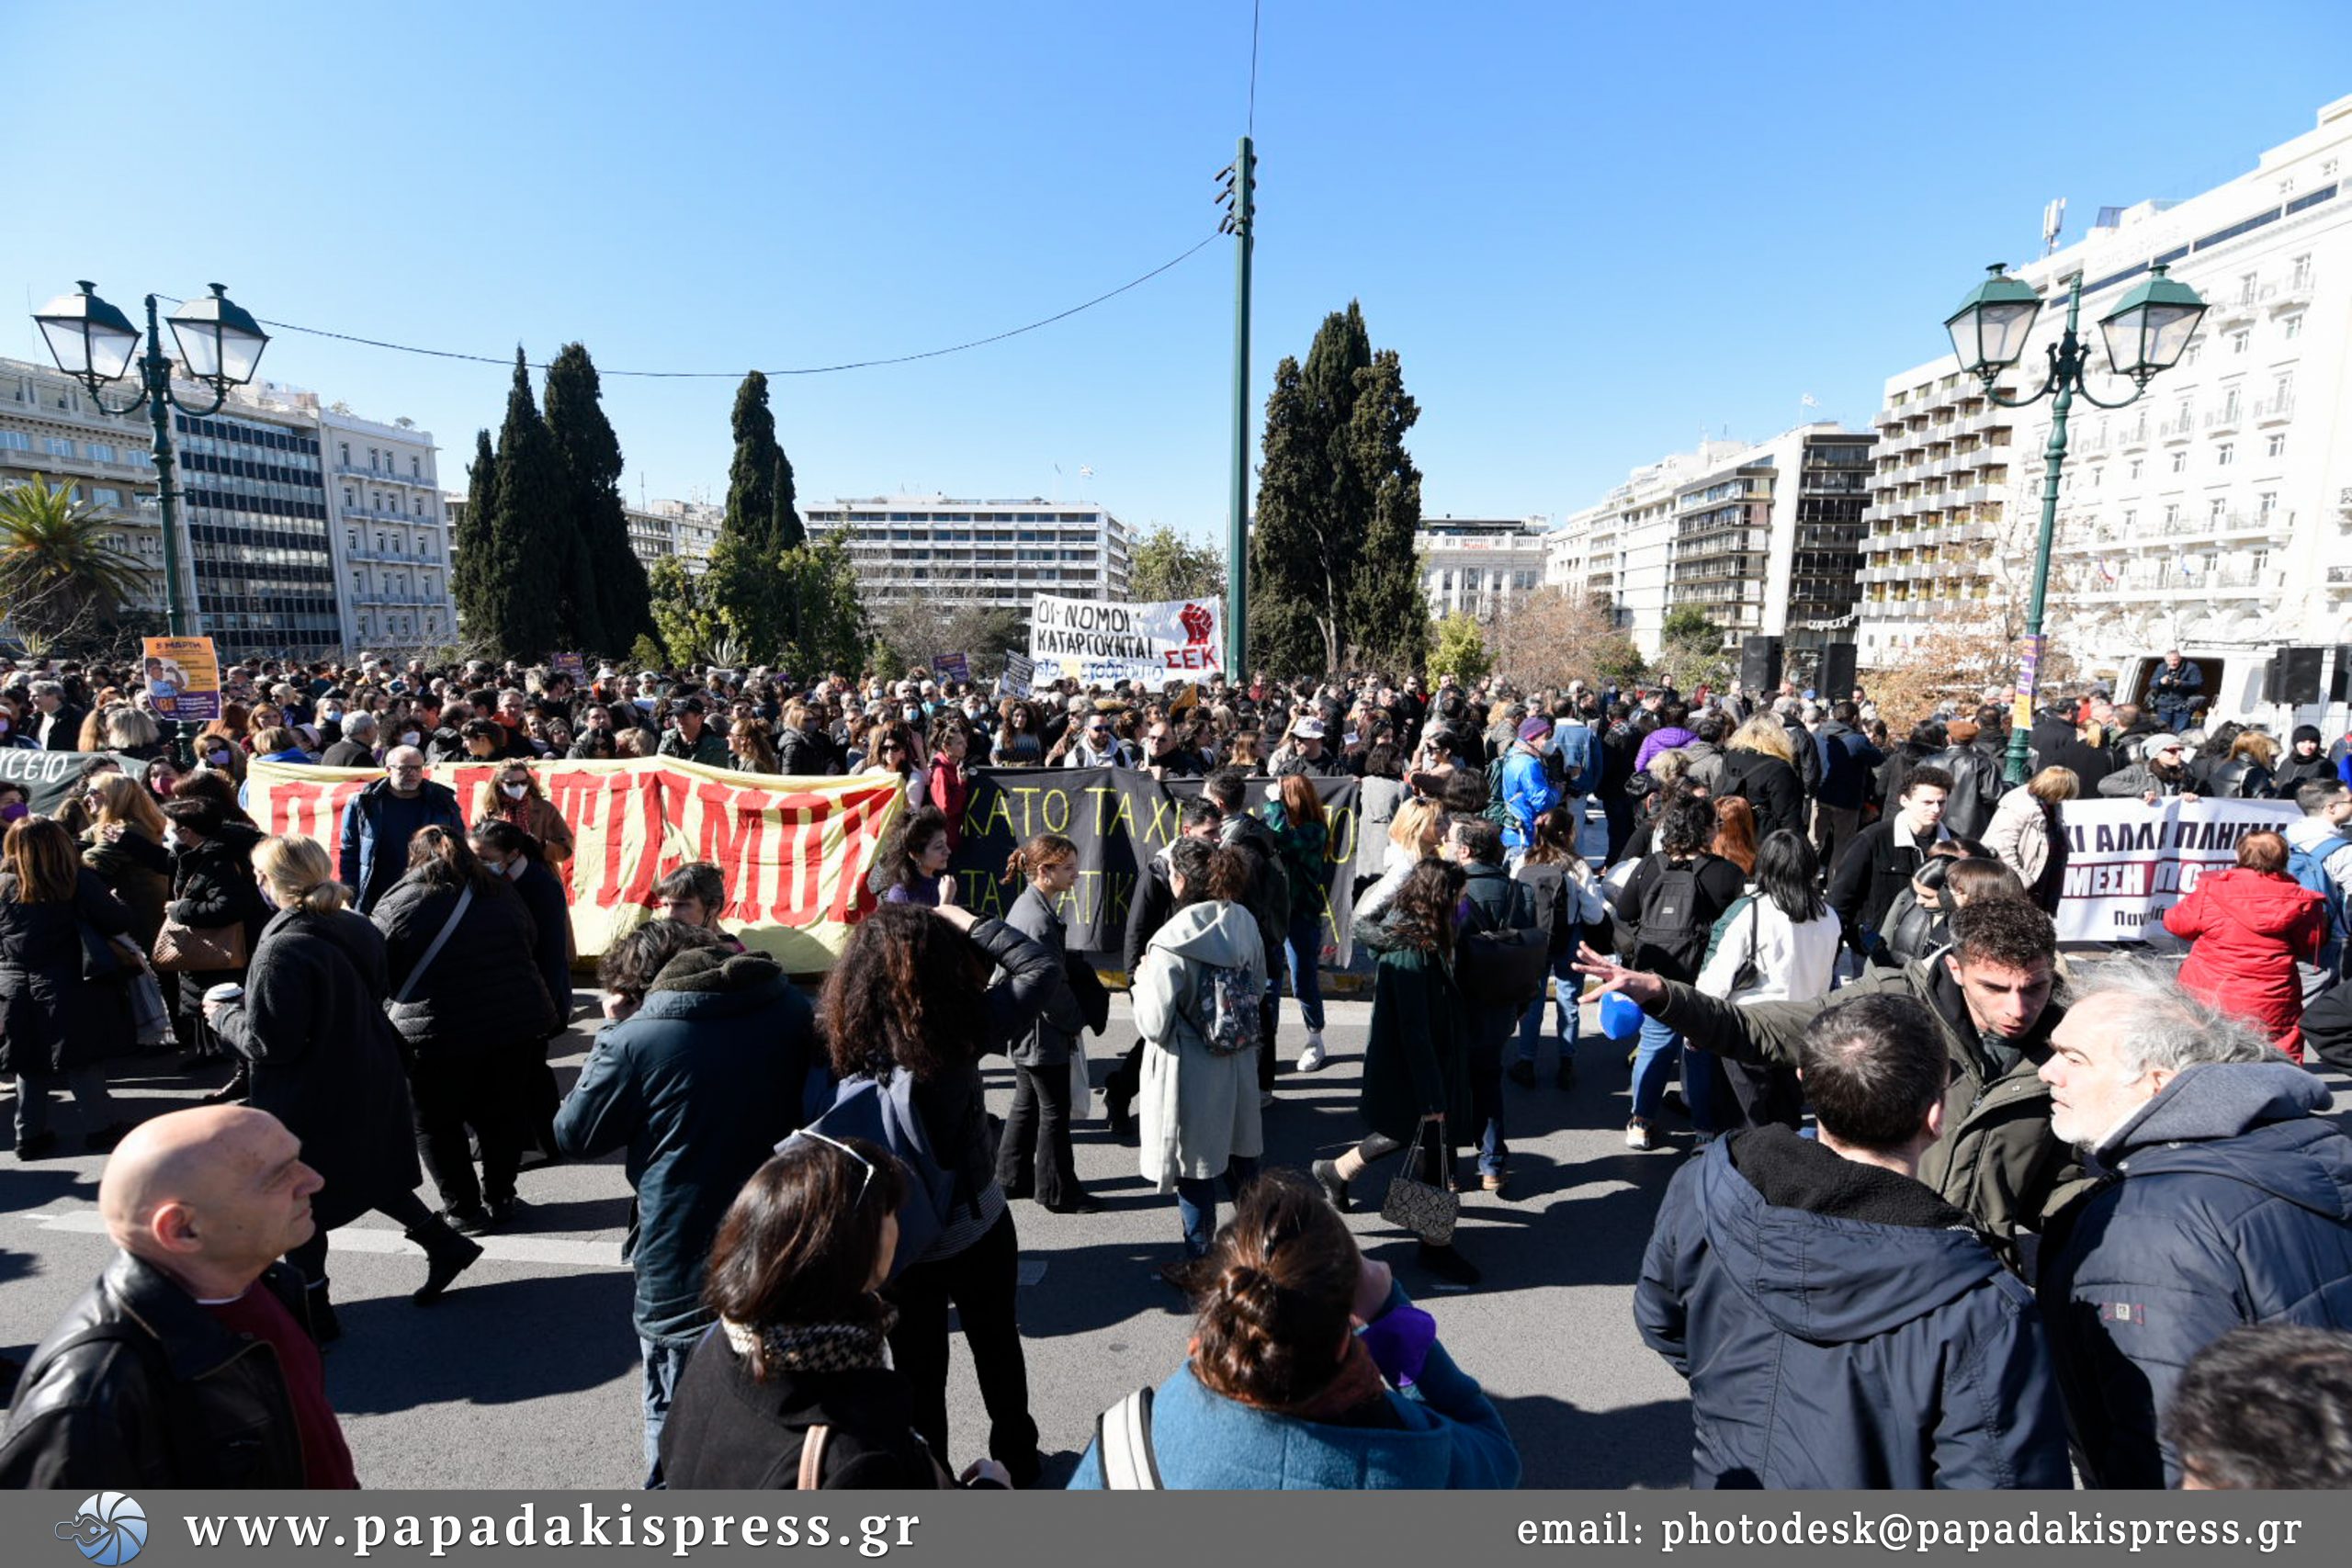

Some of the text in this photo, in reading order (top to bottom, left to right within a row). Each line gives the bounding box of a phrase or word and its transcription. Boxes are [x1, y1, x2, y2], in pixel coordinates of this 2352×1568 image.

[1038, 600, 1131, 633] ΟΙ ΝΟΜΟΙ
[1164, 645, 1220, 671] ΣΕΚ
[1085, 787, 1136, 838] ΤΑ
